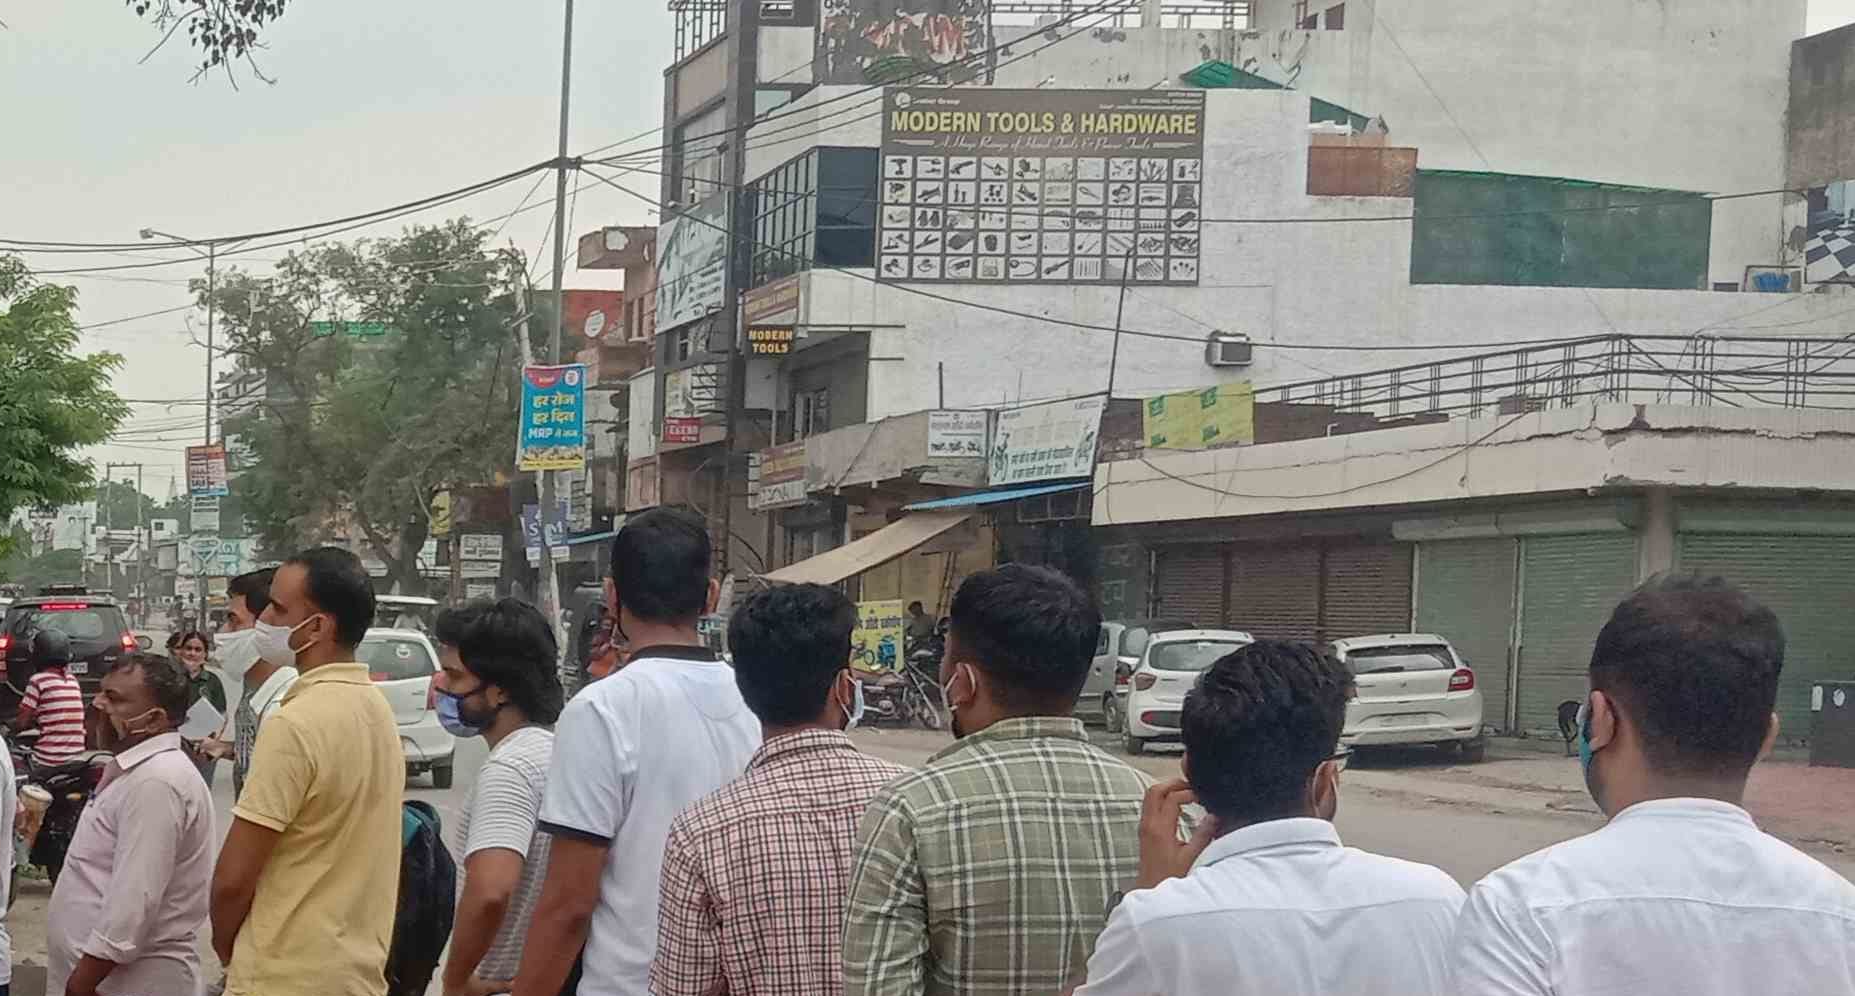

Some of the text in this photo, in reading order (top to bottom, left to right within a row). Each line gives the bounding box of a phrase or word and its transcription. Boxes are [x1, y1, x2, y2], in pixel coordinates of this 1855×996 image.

[891, 111, 1197, 134] MODERN TOOLS & HARDWARE
[749, 330, 793, 341] MODERN
[752, 343, 789, 353] TOOLS
[528, 427, 553, 439] MRP
